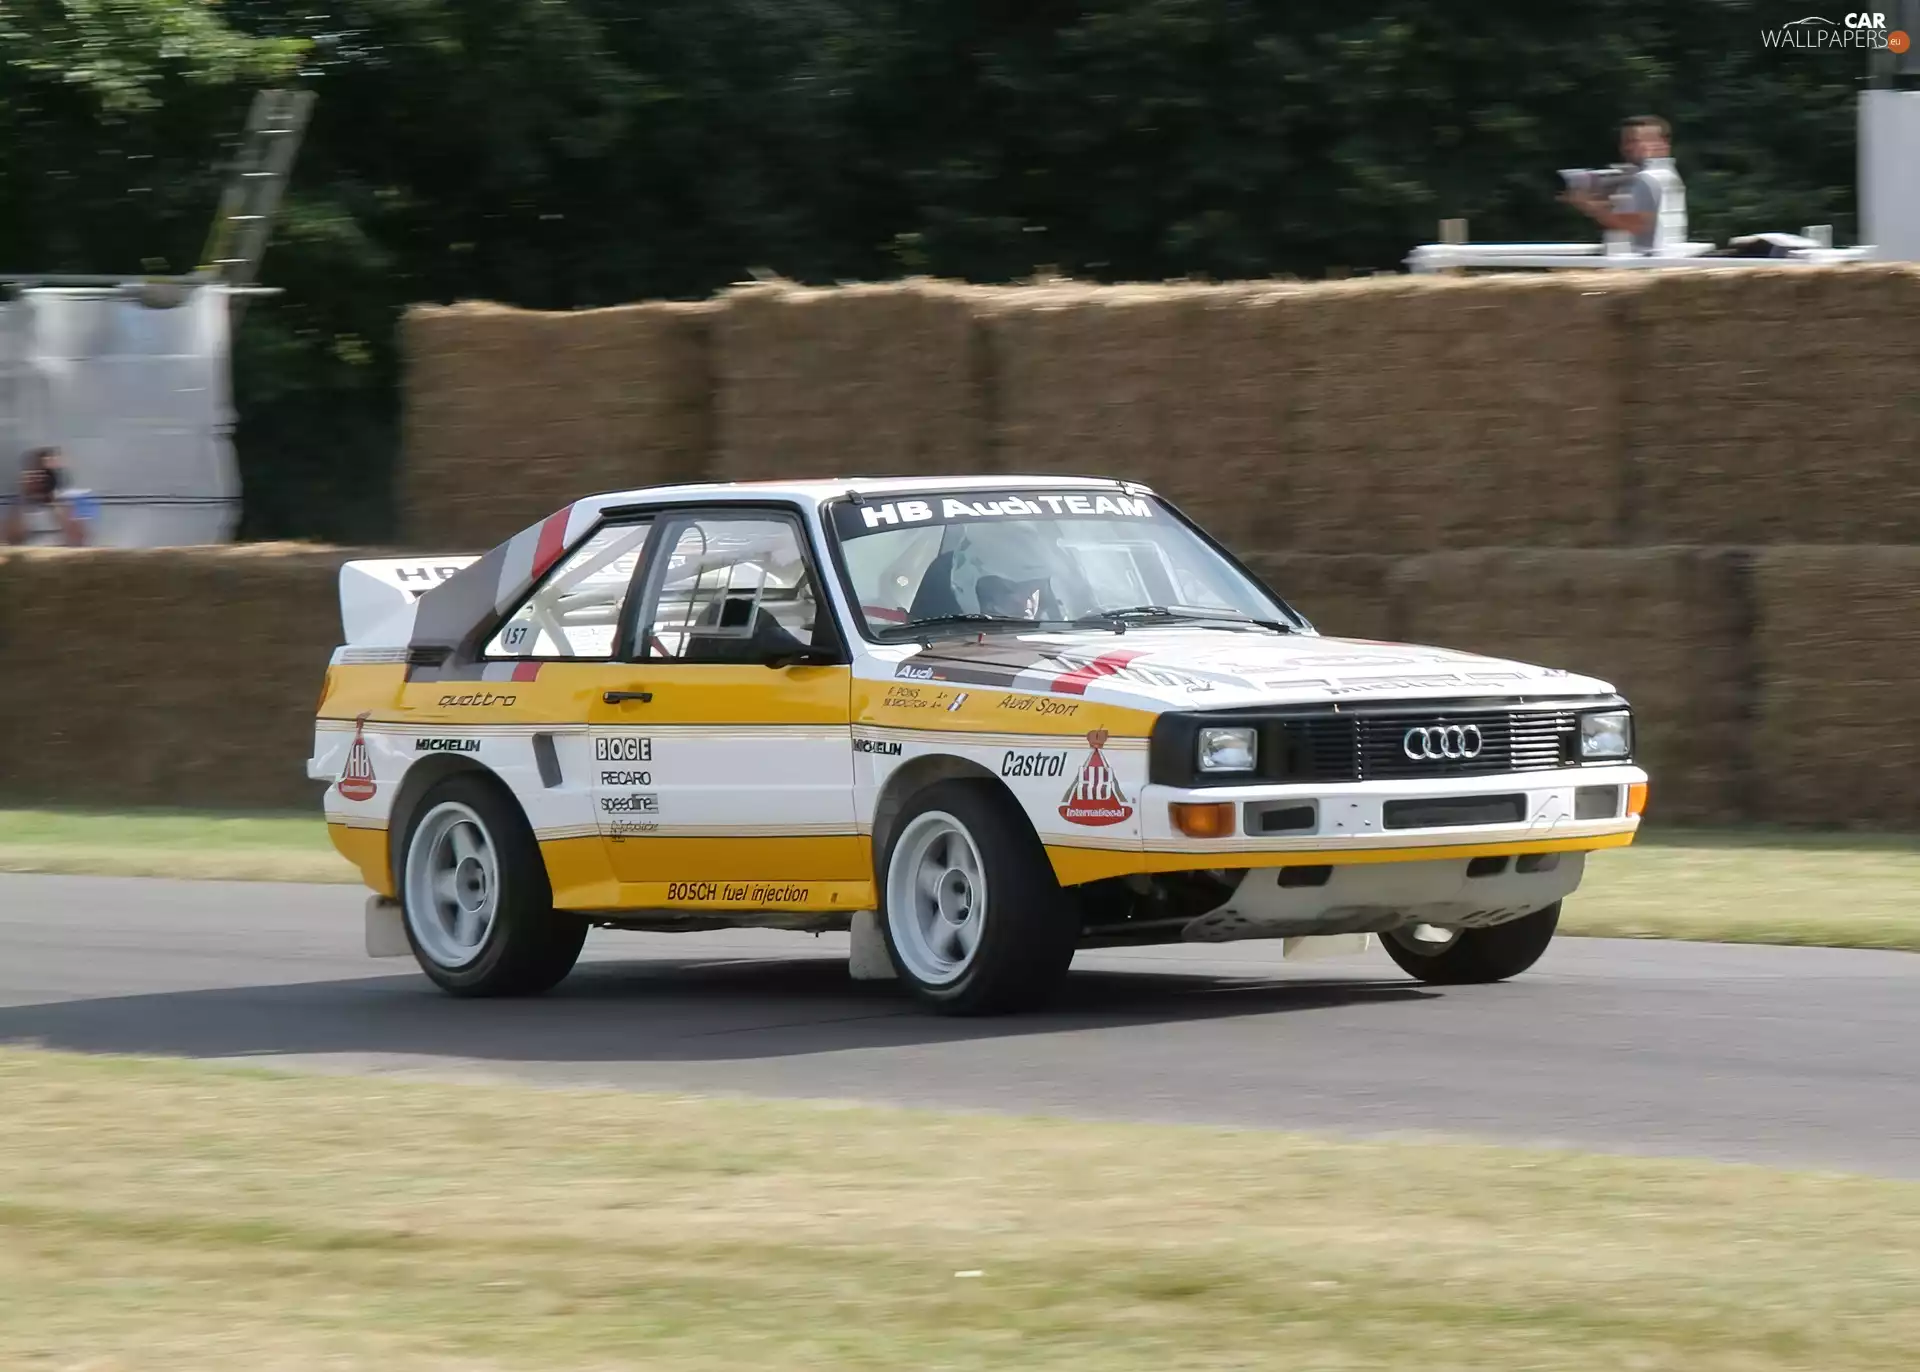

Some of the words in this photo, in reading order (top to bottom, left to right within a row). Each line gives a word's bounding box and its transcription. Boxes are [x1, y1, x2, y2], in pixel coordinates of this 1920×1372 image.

[861, 502, 932, 527] HB
[942, 497, 1042, 518] Audi
[1037, 496, 1152, 517] TEAM
[504, 627, 527, 645] 157
[896, 665, 934, 679] Audi
[438, 692, 516, 708] quattro
[997, 694, 1035, 711] Audi
[1036, 698, 1078, 716] Sport
[415, 739, 481, 751] MICHELIN
[596, 738, 652, 760] BOGE
[1001, 750, 1067, 777] Castrol
[601, 771, 652, 786] RECARO
[1076, 766, 1114, 801] HB
[601, 796, 654, 812] speedne
[1066, 807, 1125, 818] International
[668, 882, 717, 900] BOSCH
[722, 884, 749, 901] fuel
[751, 884, 808, 905] injection
